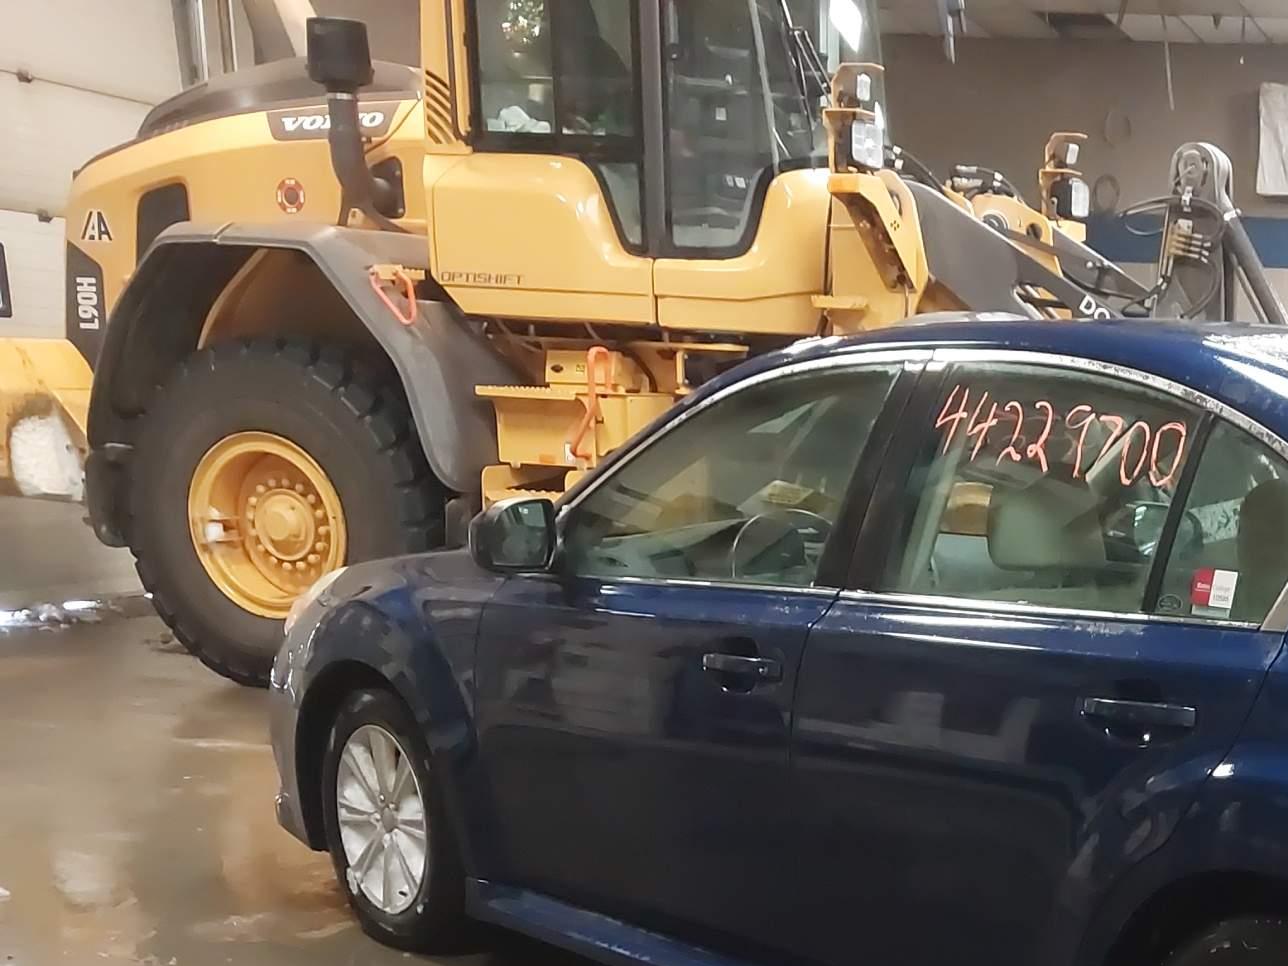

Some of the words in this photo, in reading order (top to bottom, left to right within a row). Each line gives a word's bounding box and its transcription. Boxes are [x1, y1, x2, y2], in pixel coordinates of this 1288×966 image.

[76, 277, 99, 329] L90H
[441, 271, 525, 285] OPTISHIFT
[934, 384, 1188, 487] 44229700
